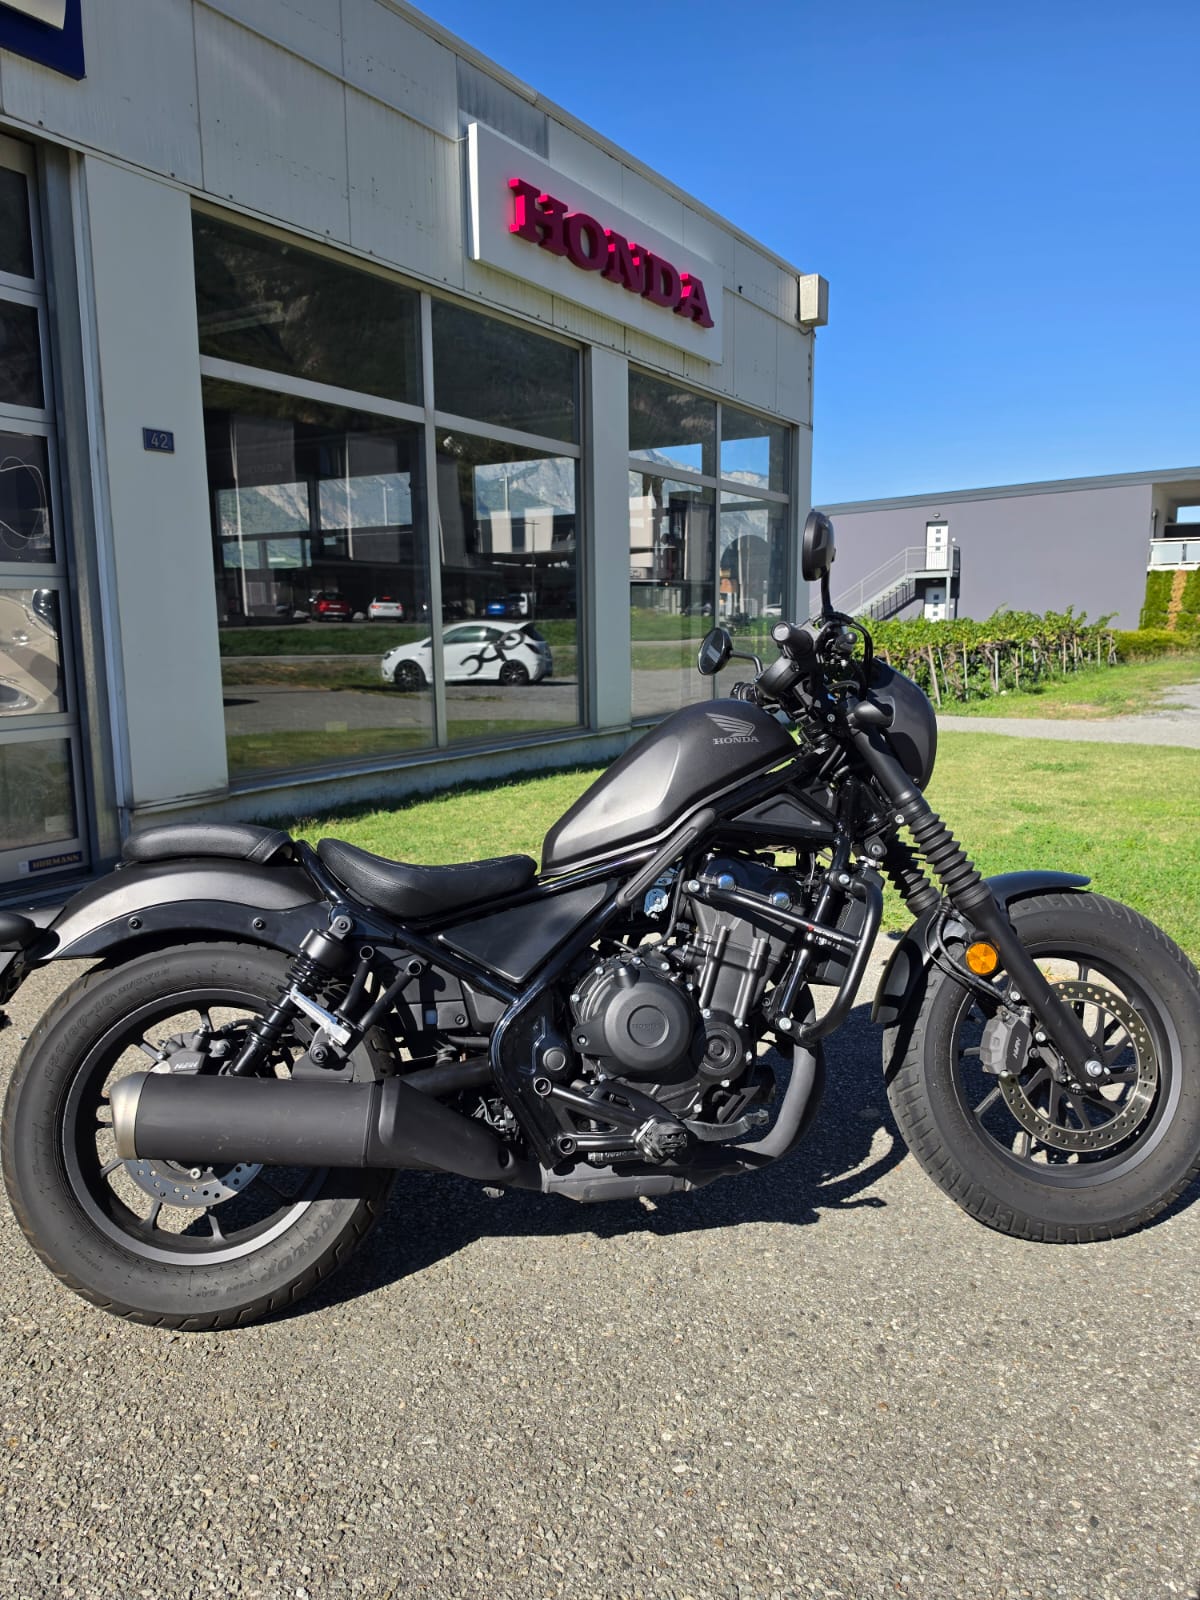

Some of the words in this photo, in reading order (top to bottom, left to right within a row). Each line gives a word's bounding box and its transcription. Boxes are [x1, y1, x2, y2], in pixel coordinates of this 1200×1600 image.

[508, 178, 715, 328] HONDA
[151, 431, 169, 449] 42
[712, 735, 760, 745] HONDA
